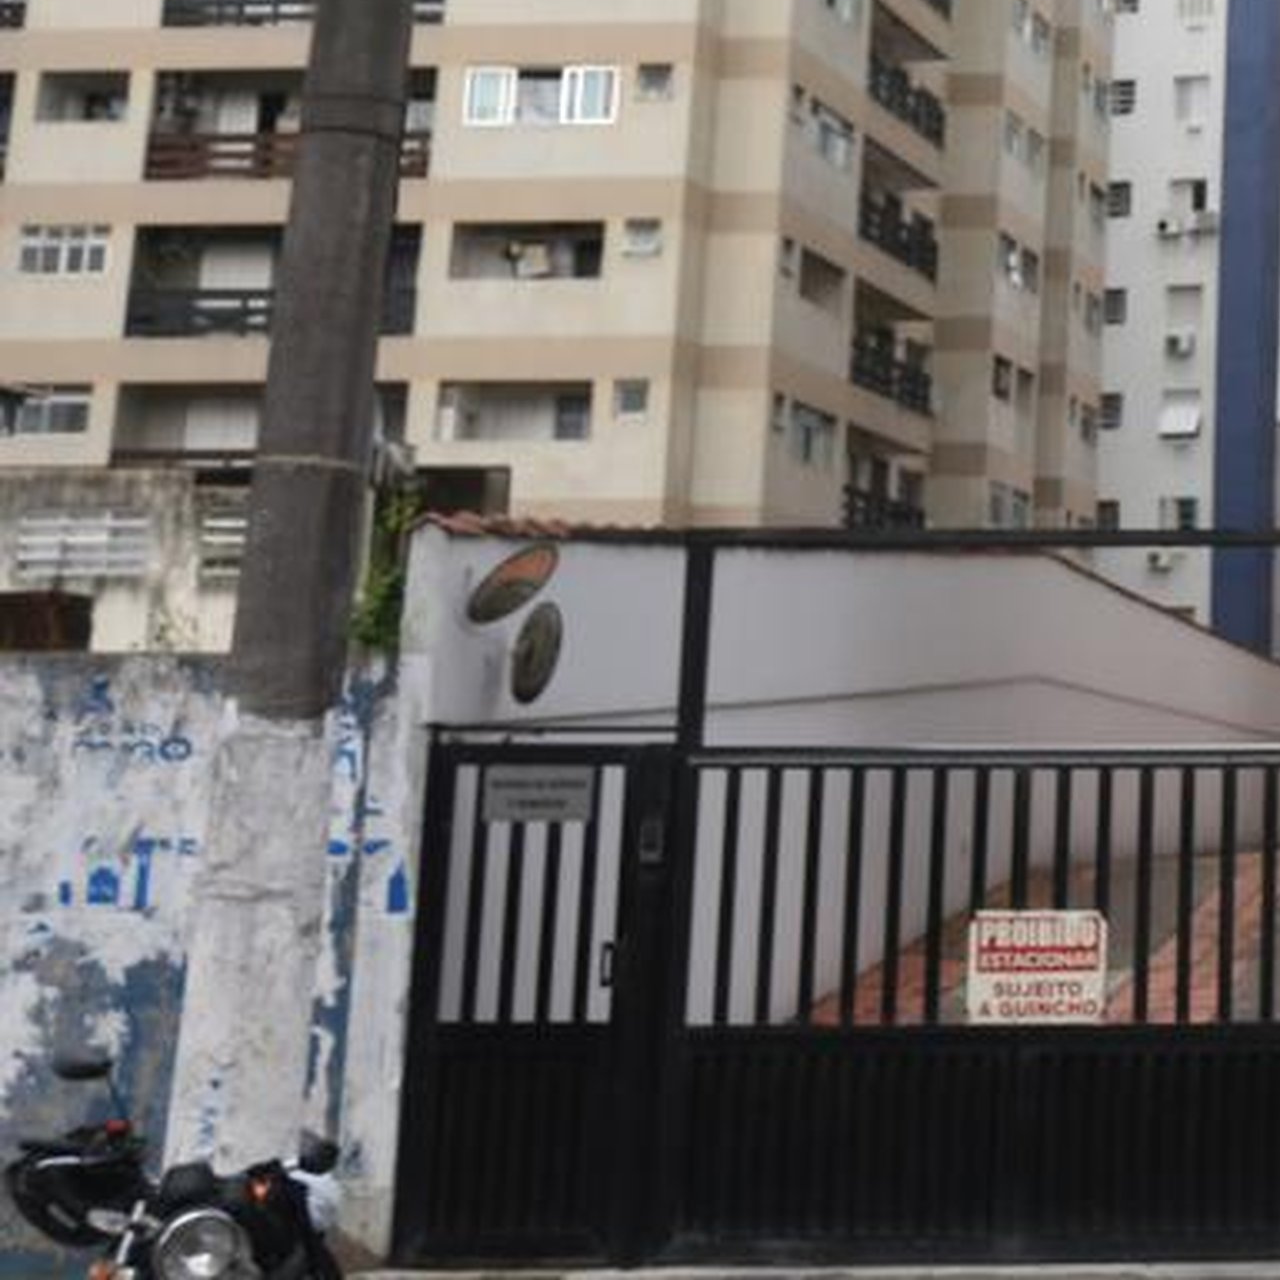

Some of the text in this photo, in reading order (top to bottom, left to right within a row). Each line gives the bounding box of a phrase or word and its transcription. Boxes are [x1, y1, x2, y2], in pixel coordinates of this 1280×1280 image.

[981, 917, 1098, 948] PROIBIDO
[981, 950, 1097, 969] ESTACIONAR
[993, 981, 1083, 998] SUJEITO
[979, 1000, 1098, 1017] A GUINCHO
